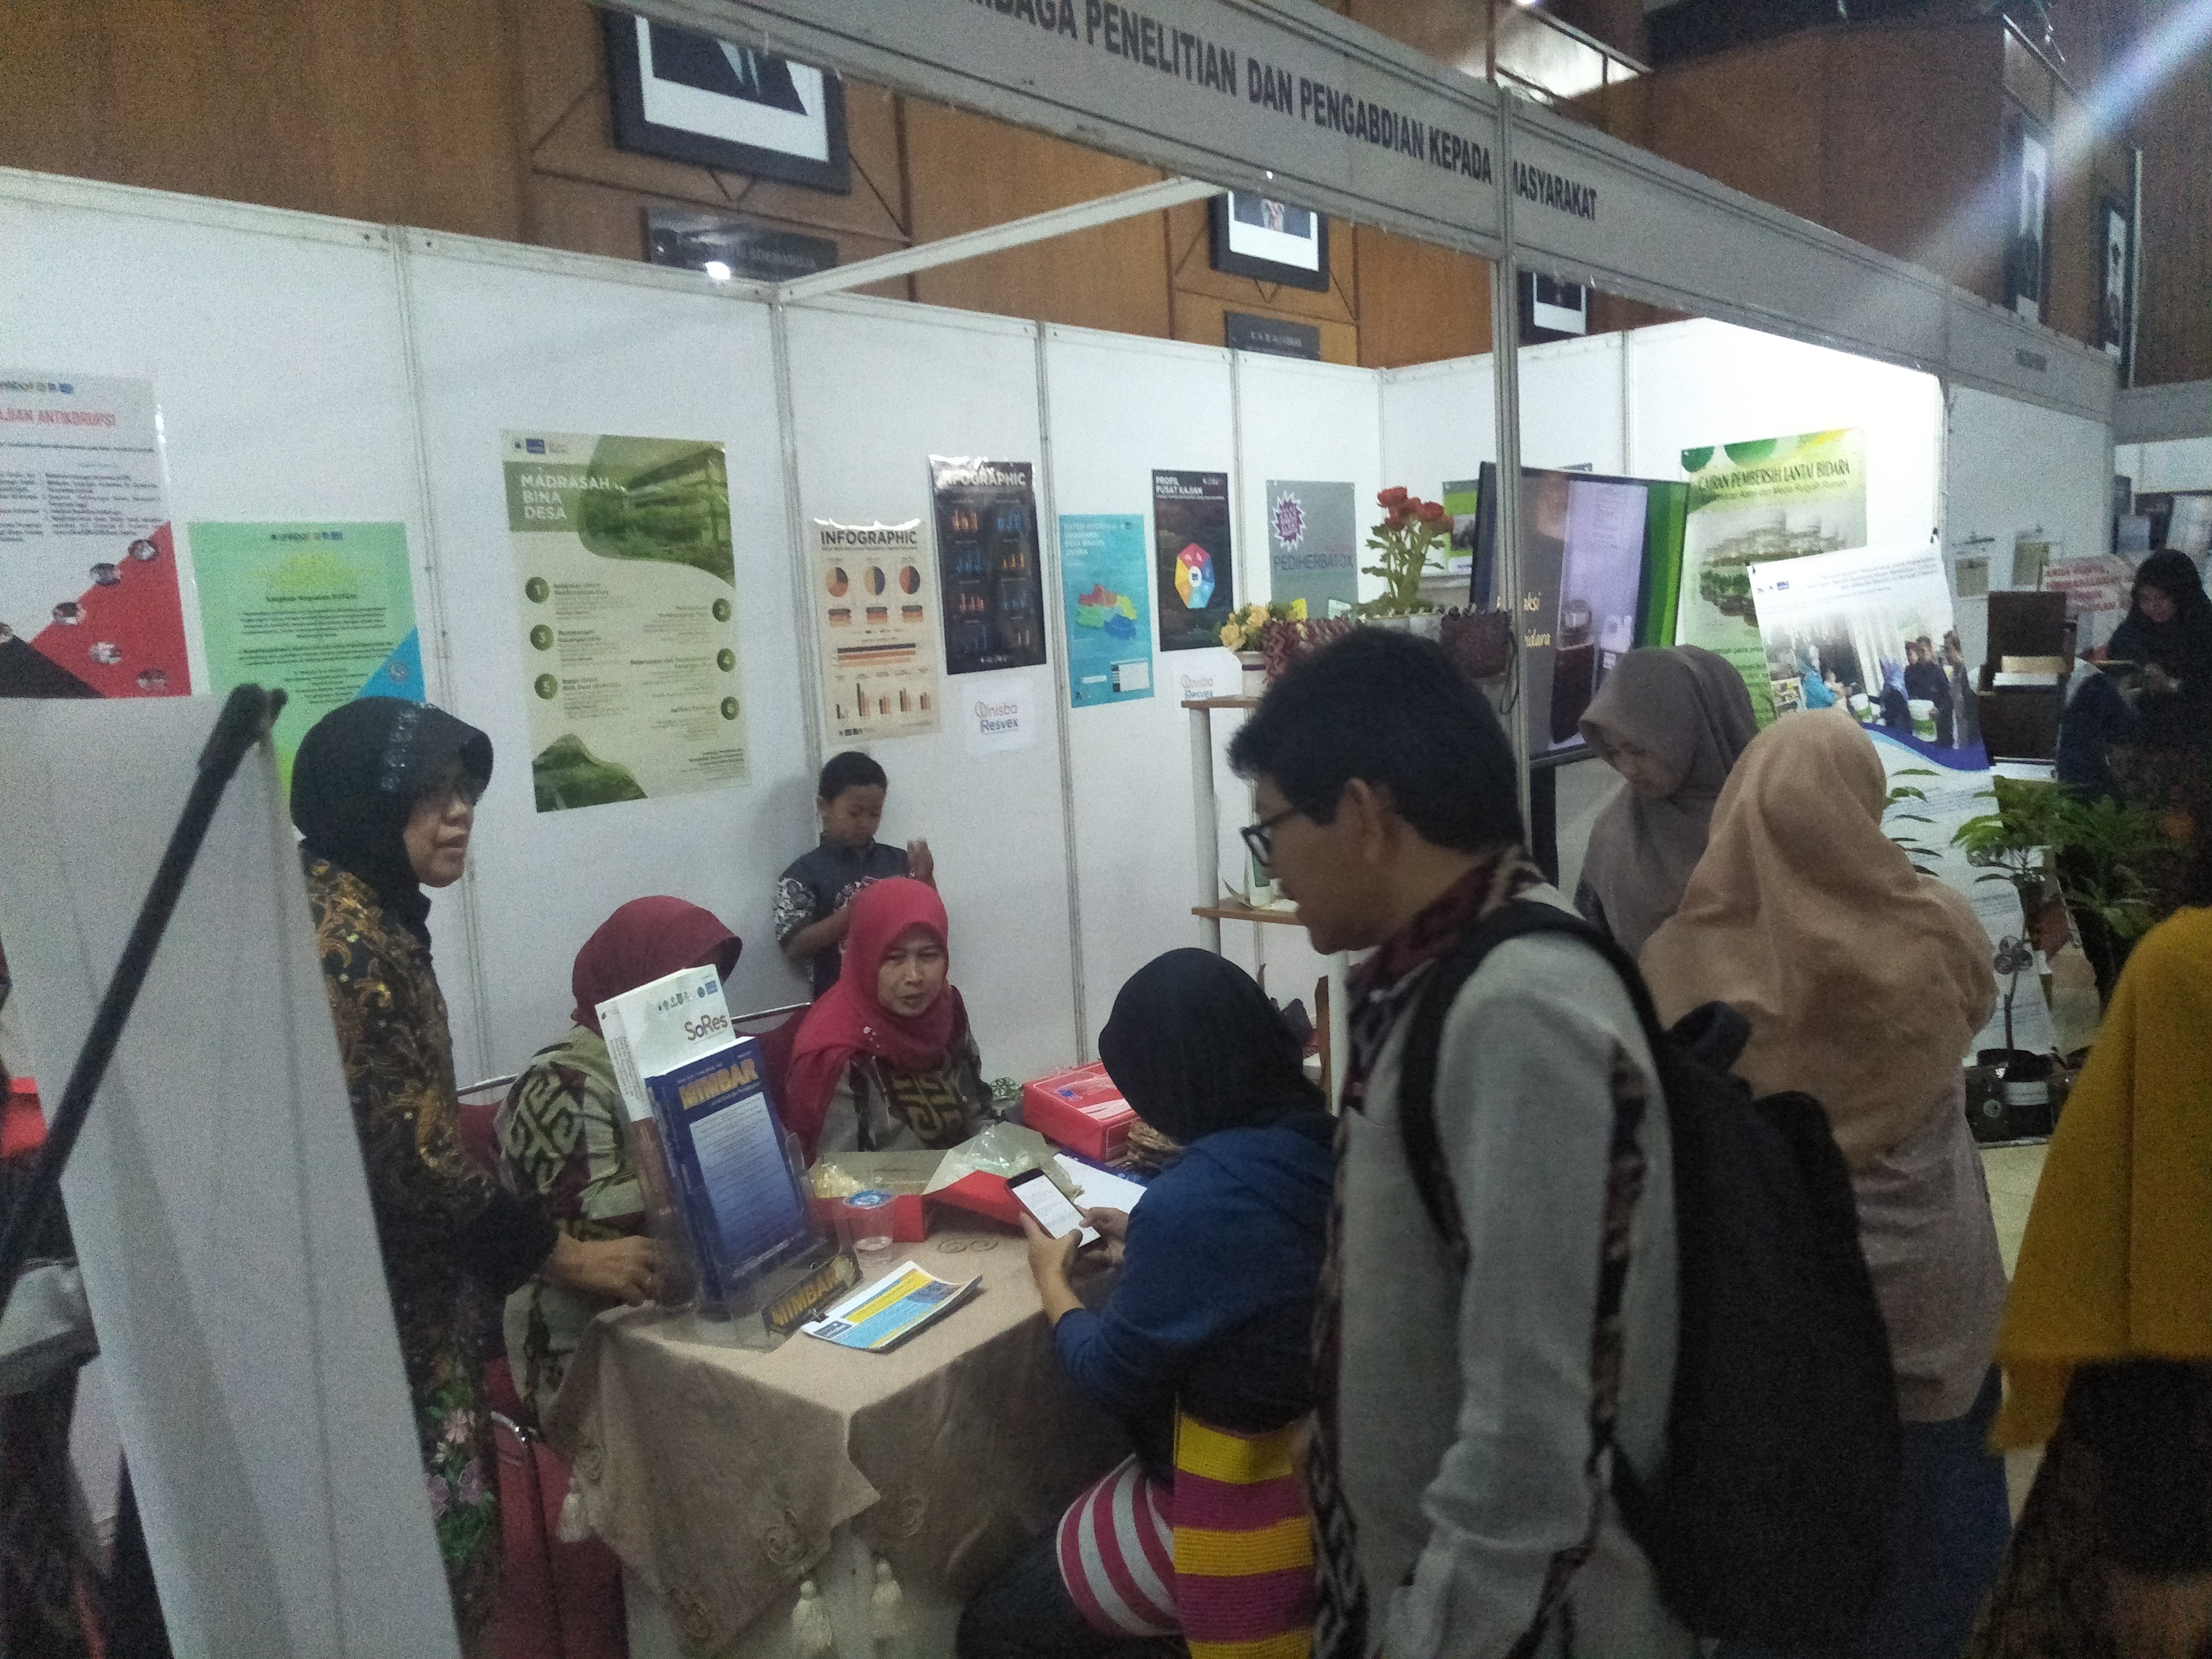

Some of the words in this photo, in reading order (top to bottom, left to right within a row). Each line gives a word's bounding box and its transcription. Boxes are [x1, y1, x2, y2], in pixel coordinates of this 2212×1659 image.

[1086, 0, 1237, 96] PENELITIAN
[1247, 57, 1293, 116] DAN
[1300, 78, 1425, 160] PENGABDIAN
[1429, 126, 1493, 185] KEPADA
[521, 474, 610, 490] MADRASAH
[940, 470, 1027, 487] NFOGRAPHIC
[522, 490, 562, 505] BINA
[524, 506, 567, 521] DESA
[820, 530, 918, 545] INFOGRAPHIC
[684, 1015, 728, 1041] SoRes
